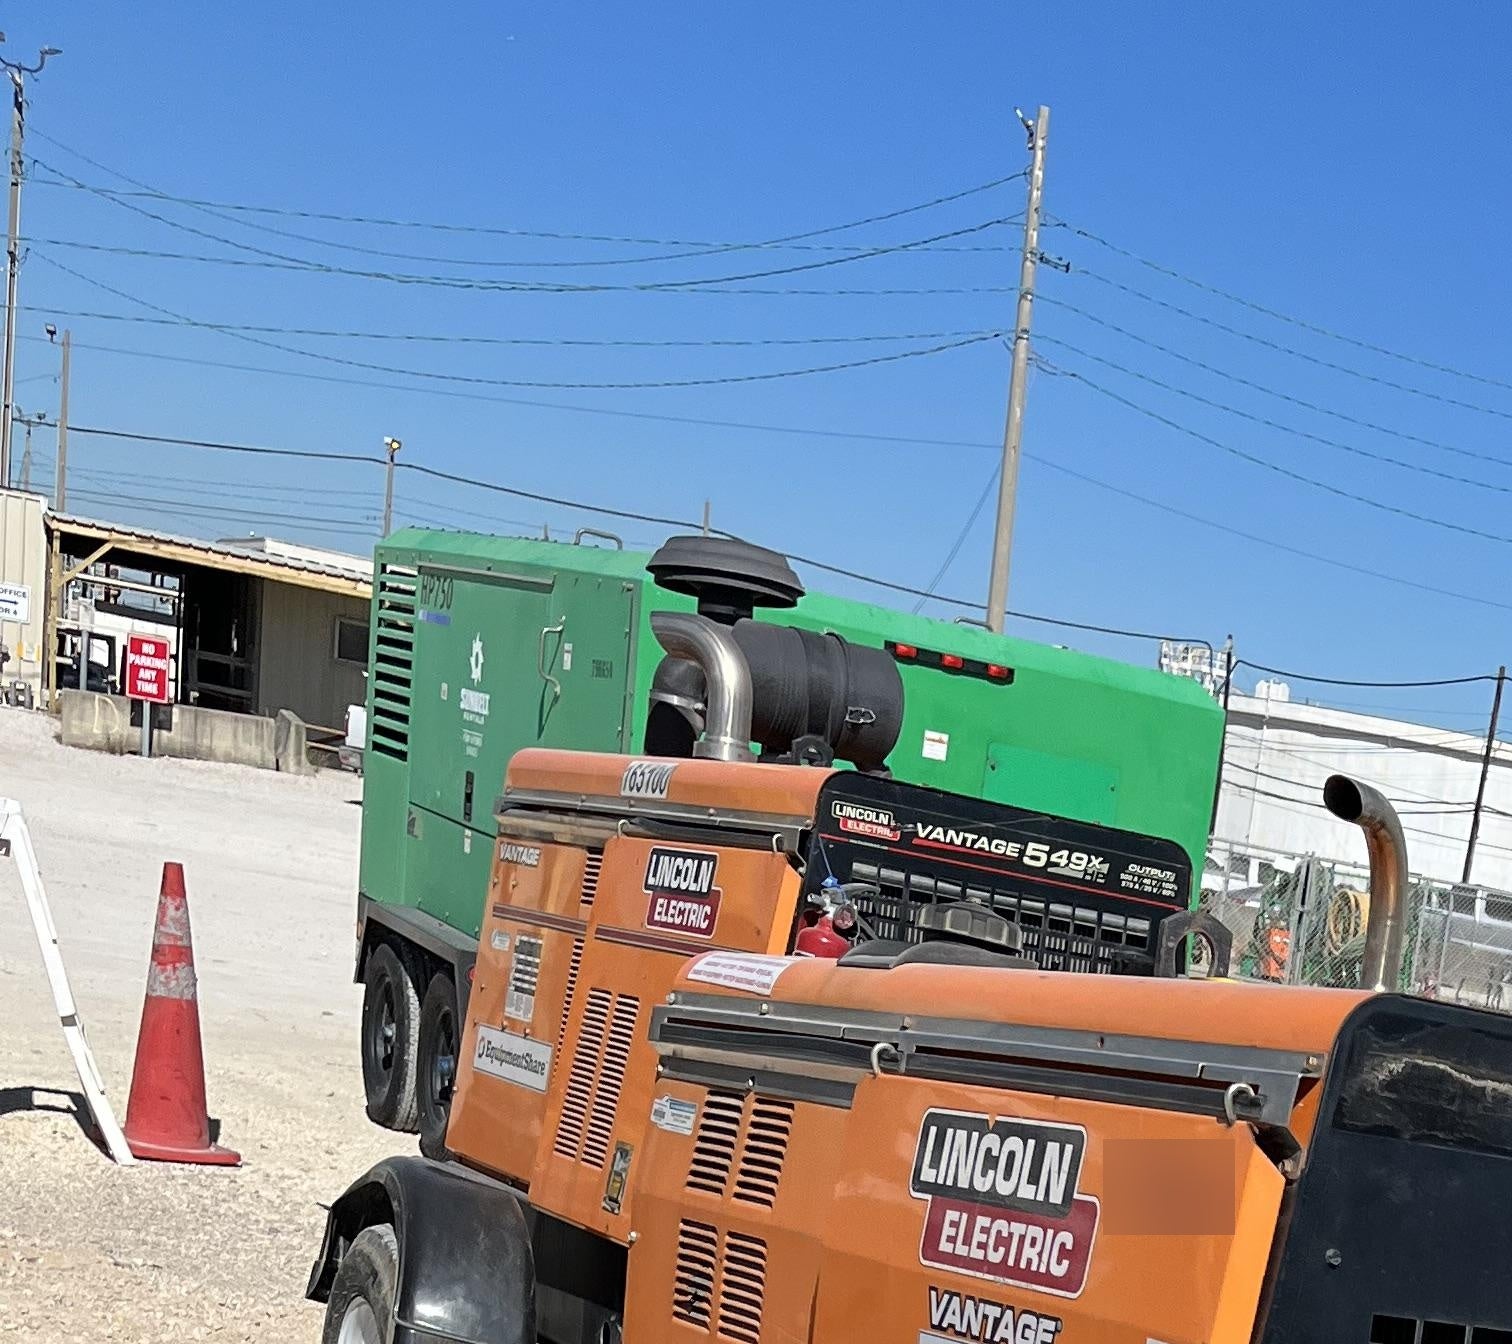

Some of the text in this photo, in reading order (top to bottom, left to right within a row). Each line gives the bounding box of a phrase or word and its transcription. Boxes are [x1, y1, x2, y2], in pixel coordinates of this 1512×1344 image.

[129, 653, 167, 670] PARKING
[142, 642, 155, 655] NO
[137, 680, 158, 695] TIME
[139, 667, 157, 682] ANY
[836, 804, 889, 825] LINCOLN
[916, 822, 1021, 857] VANTAGE
[500, 845, 539, 866] VANTAGE
[648, 854, 714, 893] LINCOLN
[653, 899, 711, 930] ELECTRIC
[485, 1041, 546, 1076] EquipmentShare
[920, 1125, 1074, 1205] LINCOLN
[939, 1210, 1073, 1277] ELECTRIC
